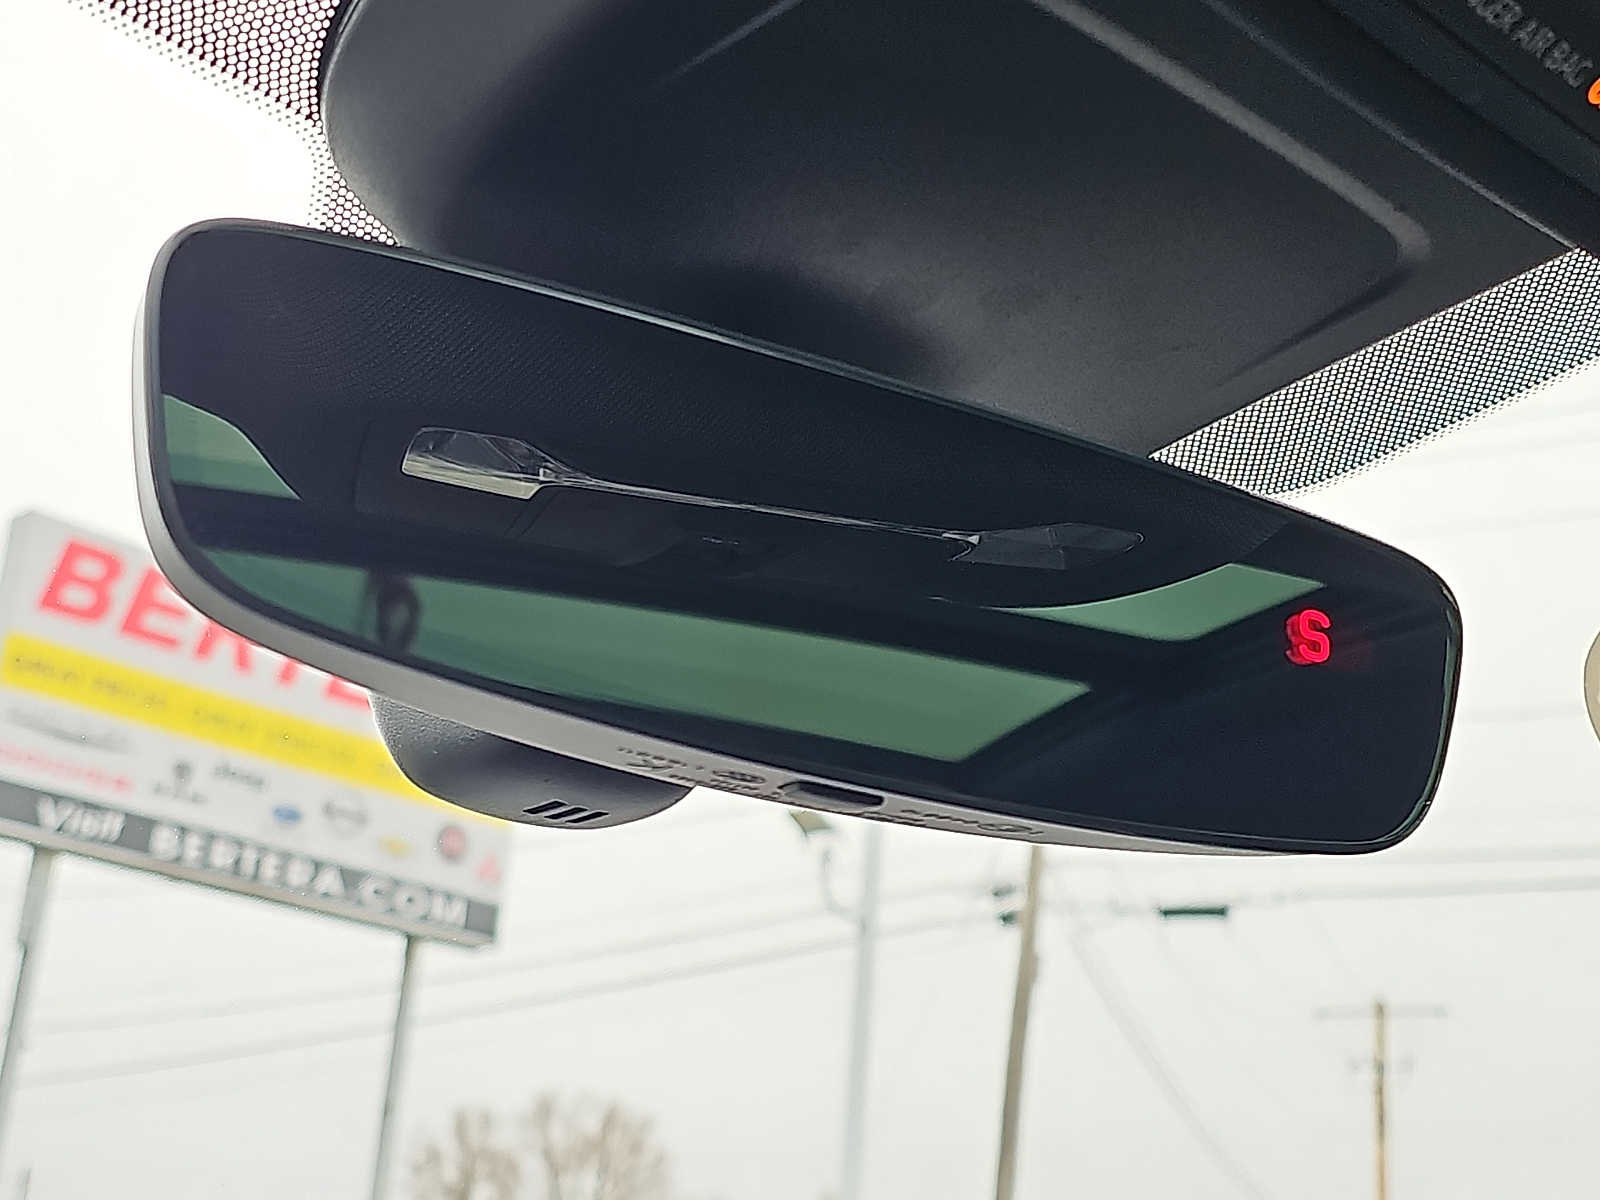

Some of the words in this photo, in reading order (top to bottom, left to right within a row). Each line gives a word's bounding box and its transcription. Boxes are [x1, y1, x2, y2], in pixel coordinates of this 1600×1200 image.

[1511, 18, 1557, 59] AIR
[1543, 39, 1594, 89] BAG
[1285, 608, 1331, 666] S
